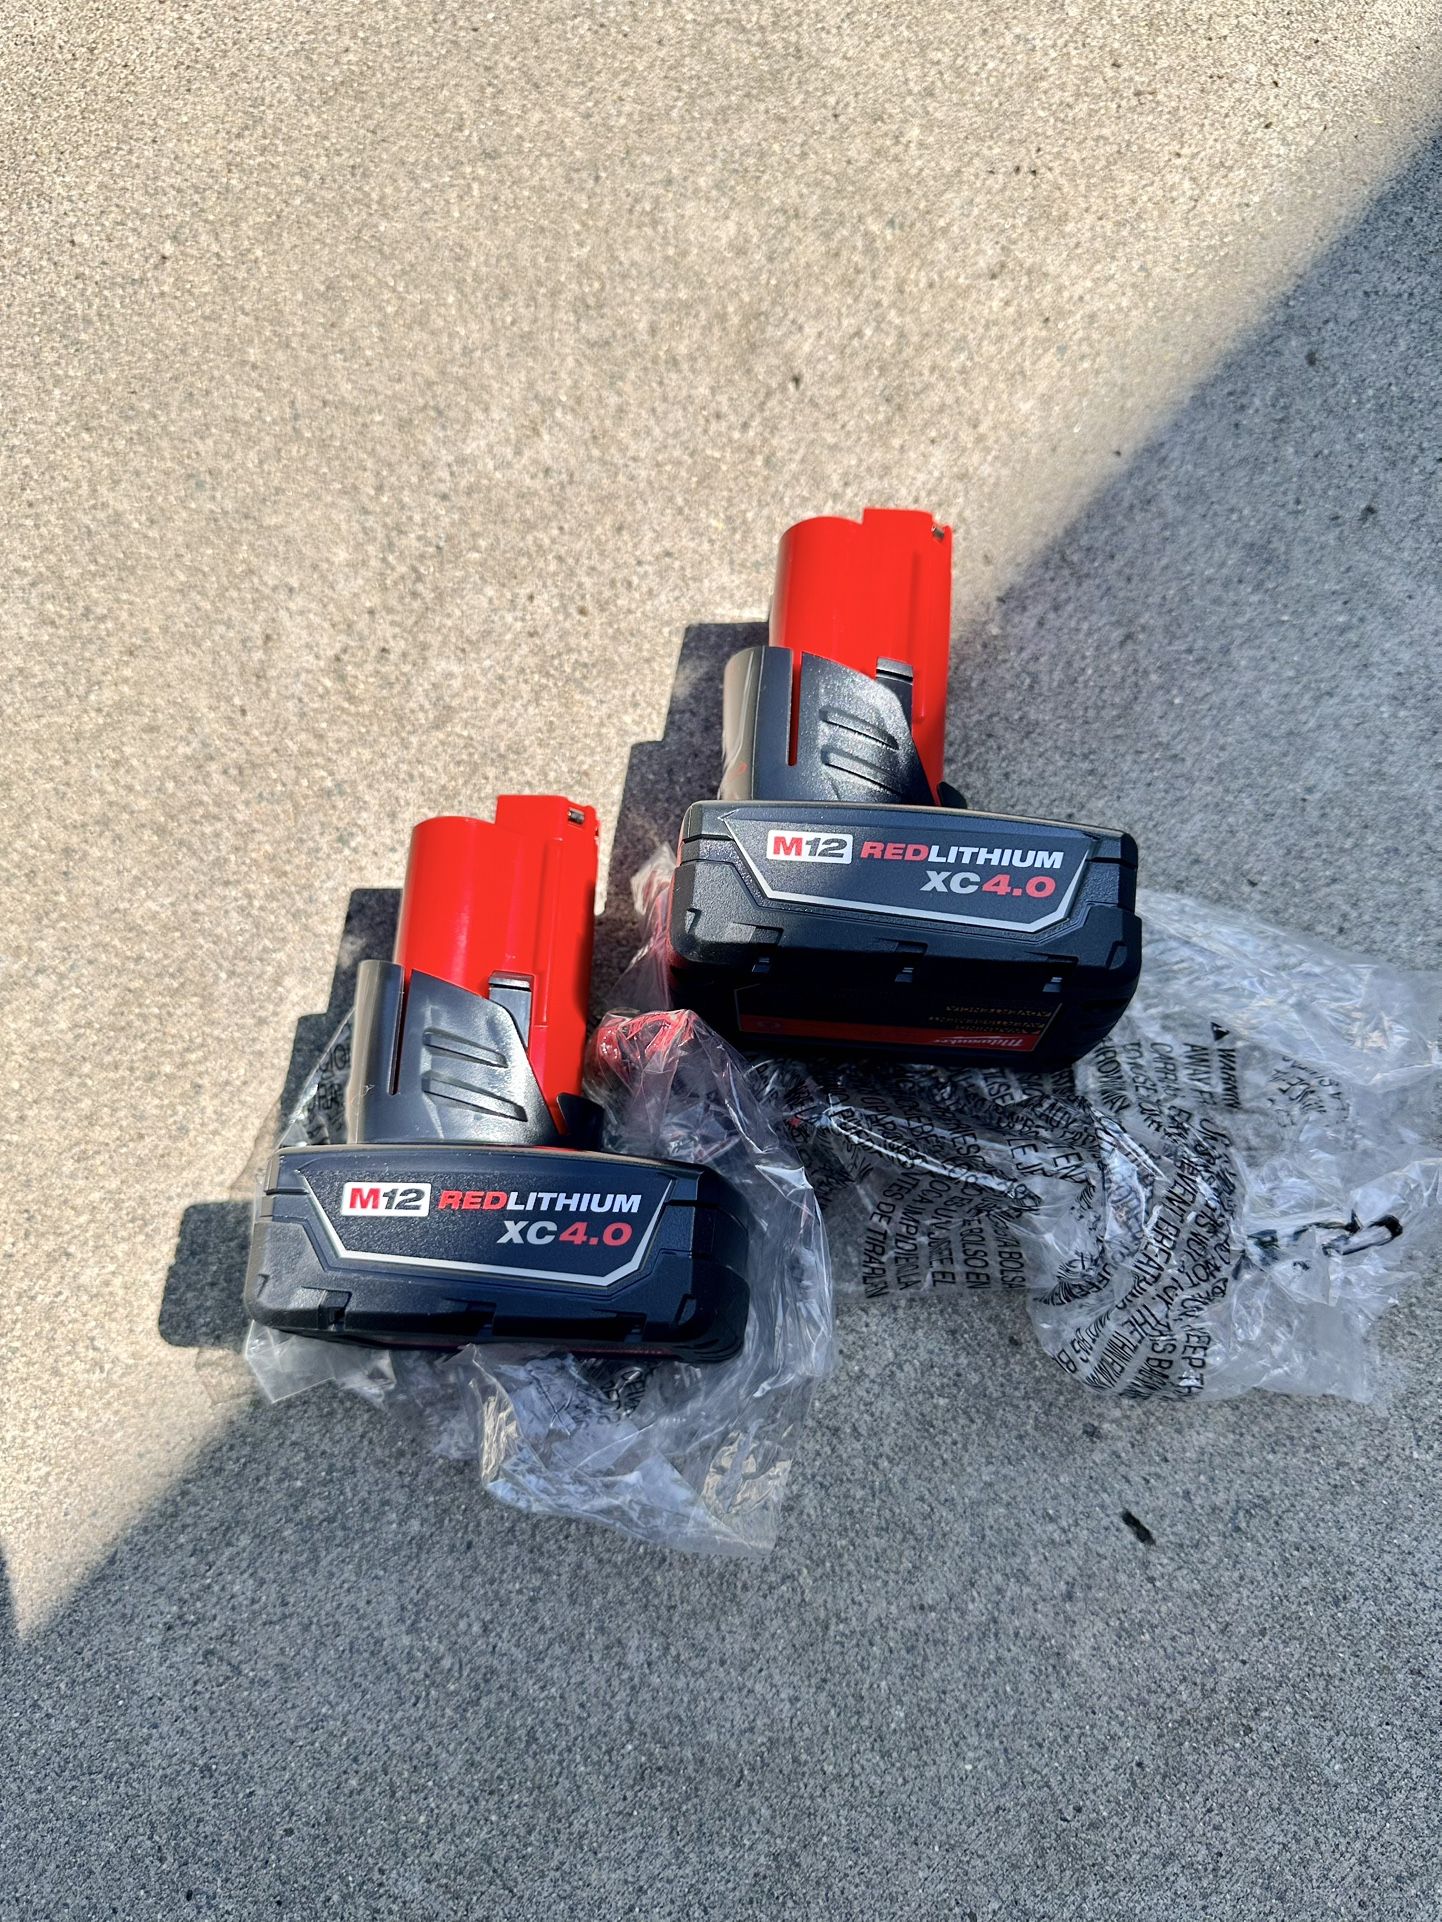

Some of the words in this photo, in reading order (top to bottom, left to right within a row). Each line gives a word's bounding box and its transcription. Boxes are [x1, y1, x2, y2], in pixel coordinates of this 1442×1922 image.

[771, 835, 848, 858] M12
[860, 841, 1065, 869] REDLITHIUM
[347, 1186, 427, 1212] M12
[437, 1190, 642, 1213] REDLITHIUM
[869, 1201, 896, 1225] DE
[932, 1272, 956, 1287] EL
[966, 1272, 991, 1288] EN
